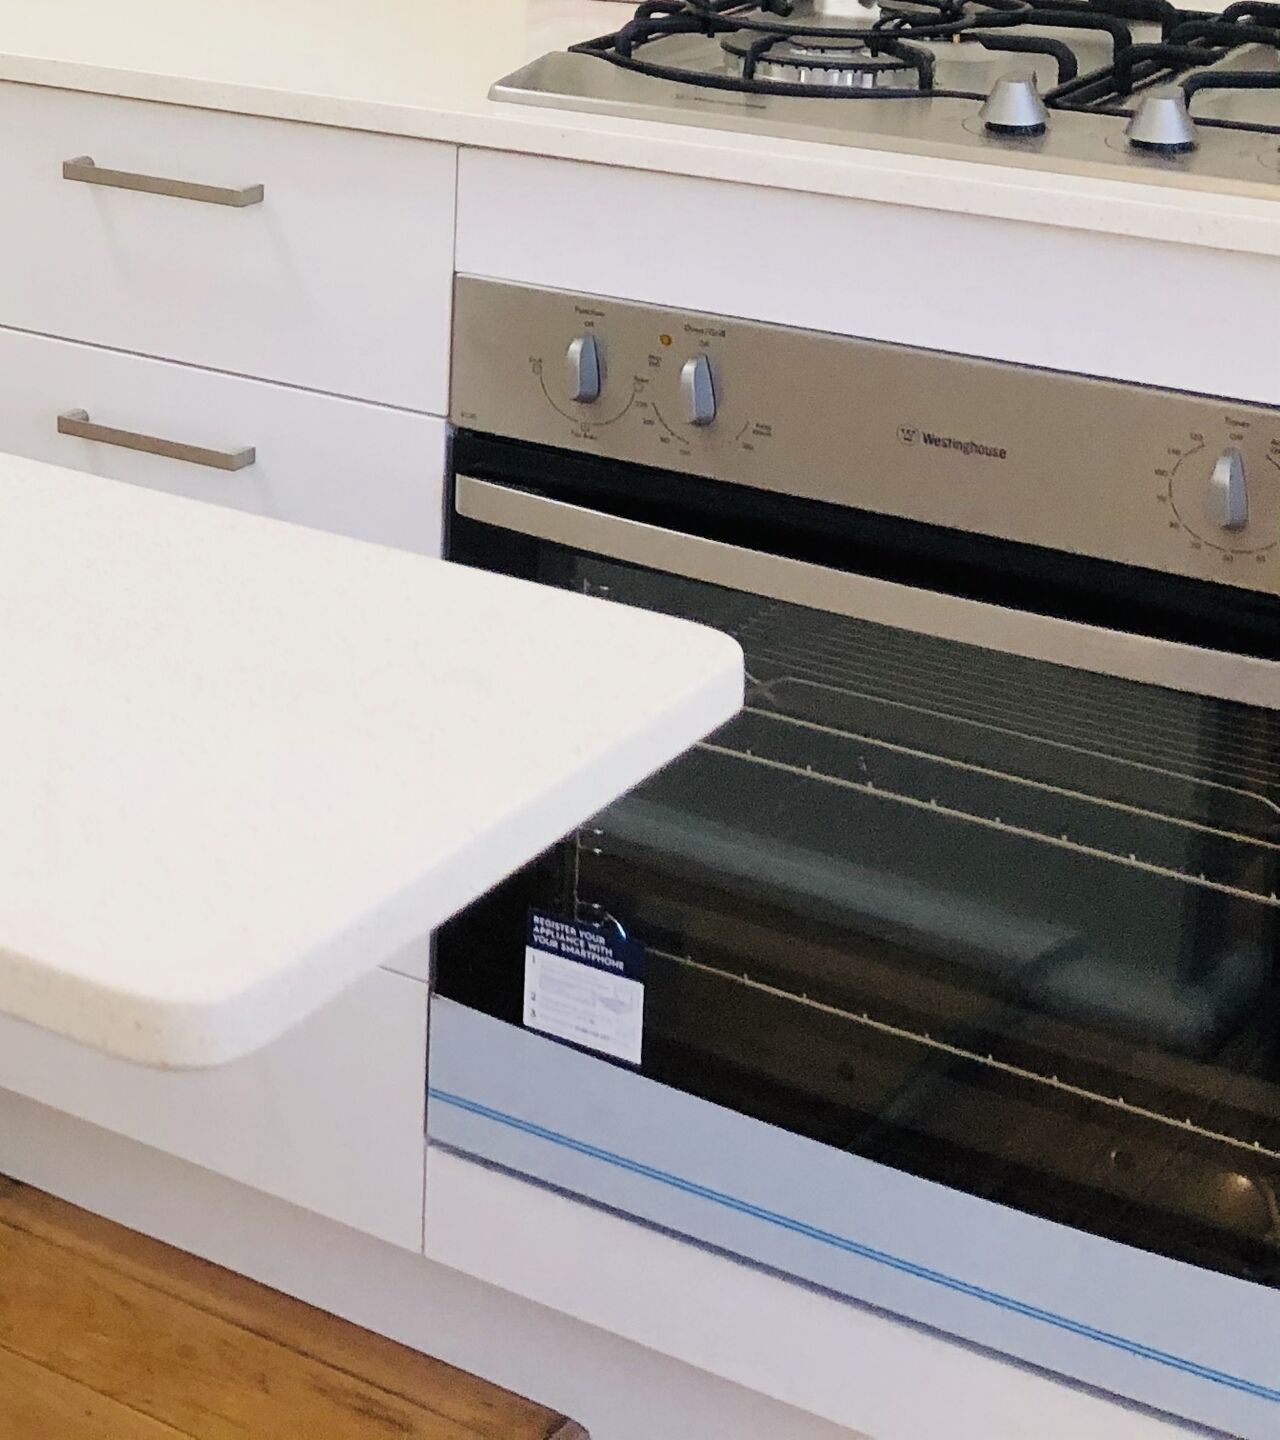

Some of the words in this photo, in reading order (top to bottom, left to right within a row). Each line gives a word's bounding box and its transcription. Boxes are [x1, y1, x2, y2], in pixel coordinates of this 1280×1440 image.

[921, 430, 1008, 460] Westinghouse
[533, 915, 577, 935] REGISTER
[579, 929, 606, 946] YOUR
[533, 925, 585, 948] APPLIANCE
[587, 941, 613, 958] WITH
[533, 934, 559, 949] YOUR
[561, 942, 625, 971] SMARTPHONE
